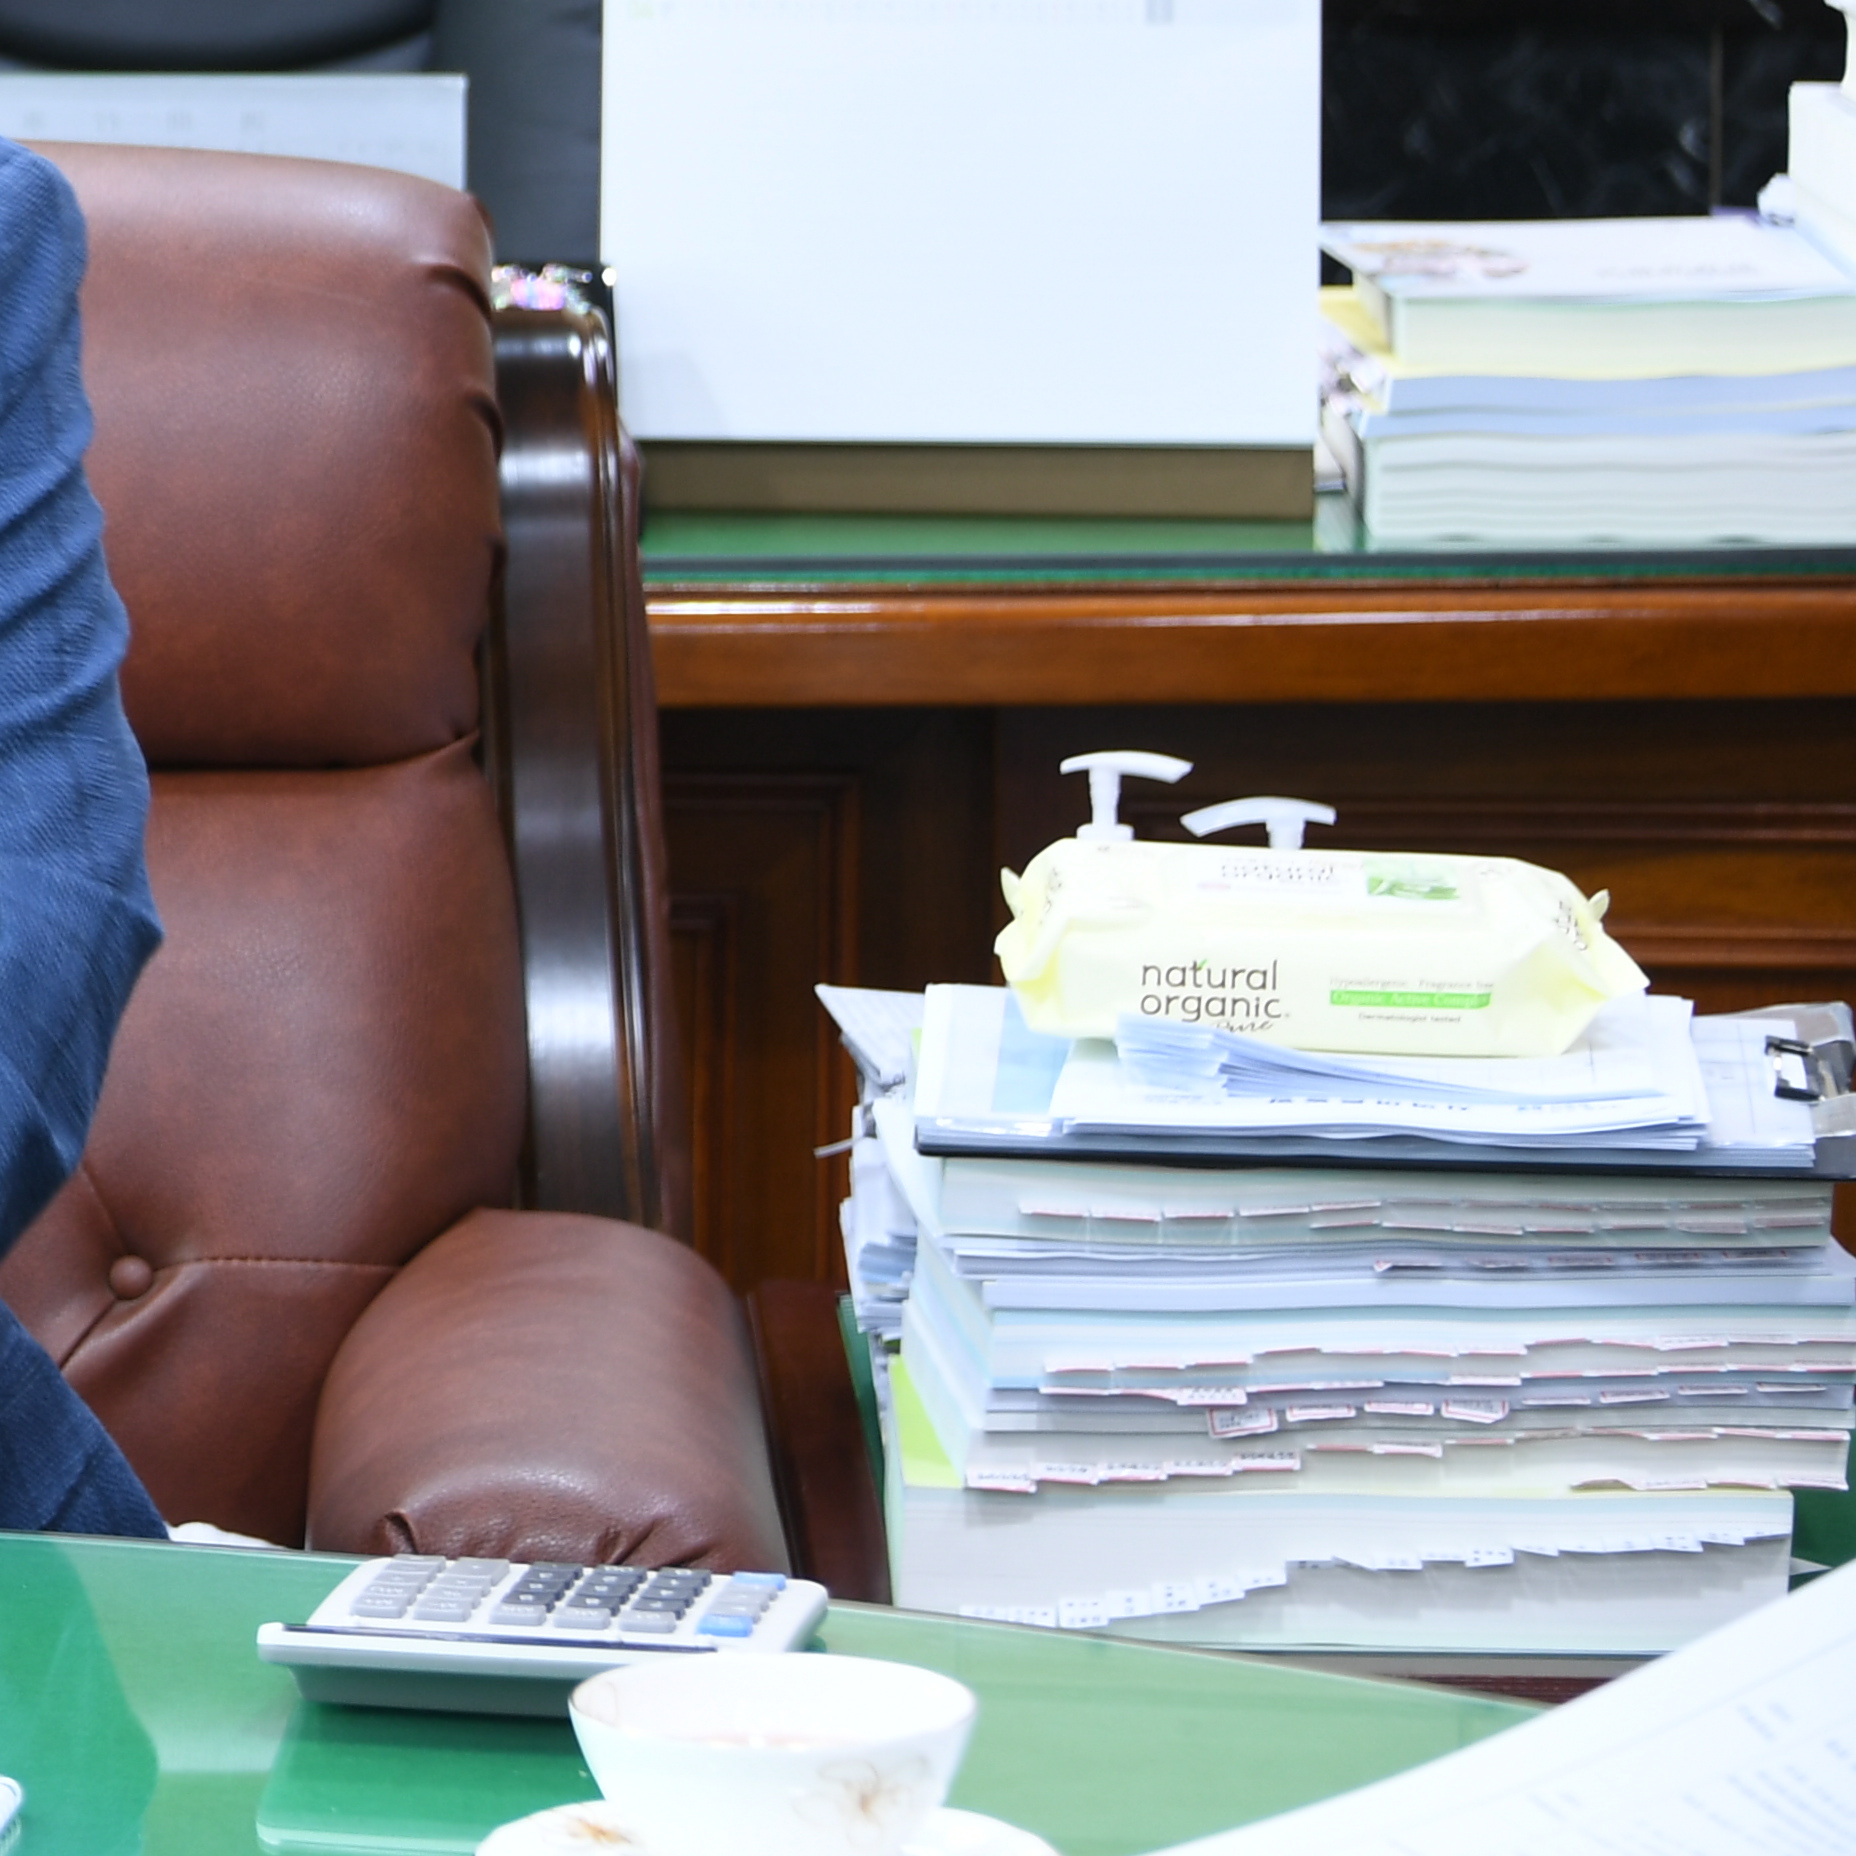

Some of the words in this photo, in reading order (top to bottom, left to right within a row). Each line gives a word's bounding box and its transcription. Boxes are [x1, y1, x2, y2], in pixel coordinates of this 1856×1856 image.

[1142, 959, 1278, 991] natural
[1140, 994, 1282, 1023] organic
[1332, 991, 1384, 1006] Organic
